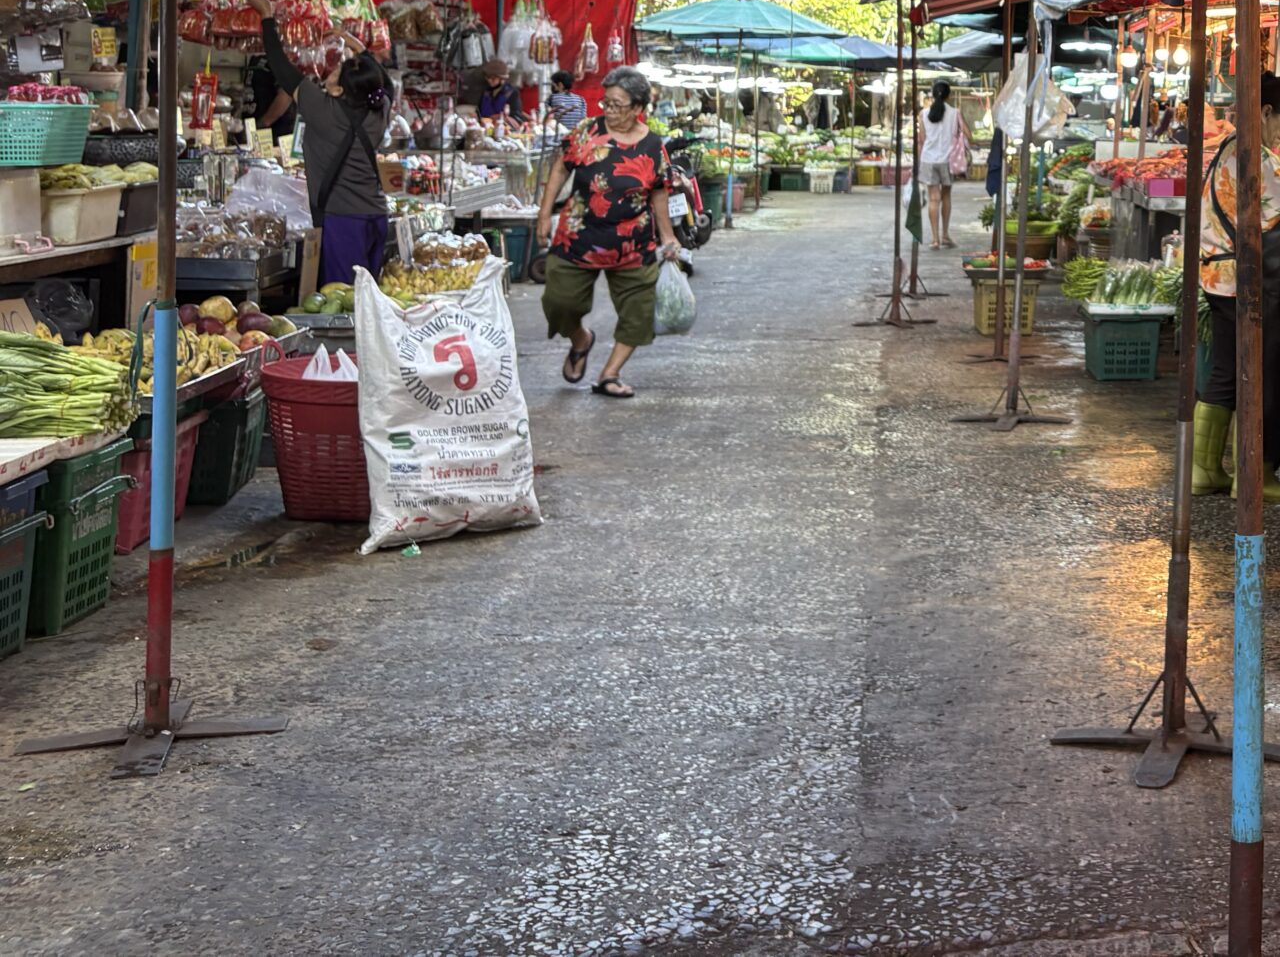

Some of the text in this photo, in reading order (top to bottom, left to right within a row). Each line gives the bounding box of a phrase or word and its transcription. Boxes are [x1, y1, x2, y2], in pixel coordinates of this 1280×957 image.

[400, 366, 444, 411] RAYONG
[444, 392, 495, 417] SUGAR
[417, 421, 510, 438] GOLDEN BROWN SUGAR
[425, 432, 504, 446] PRODUCT OF THAILAND
